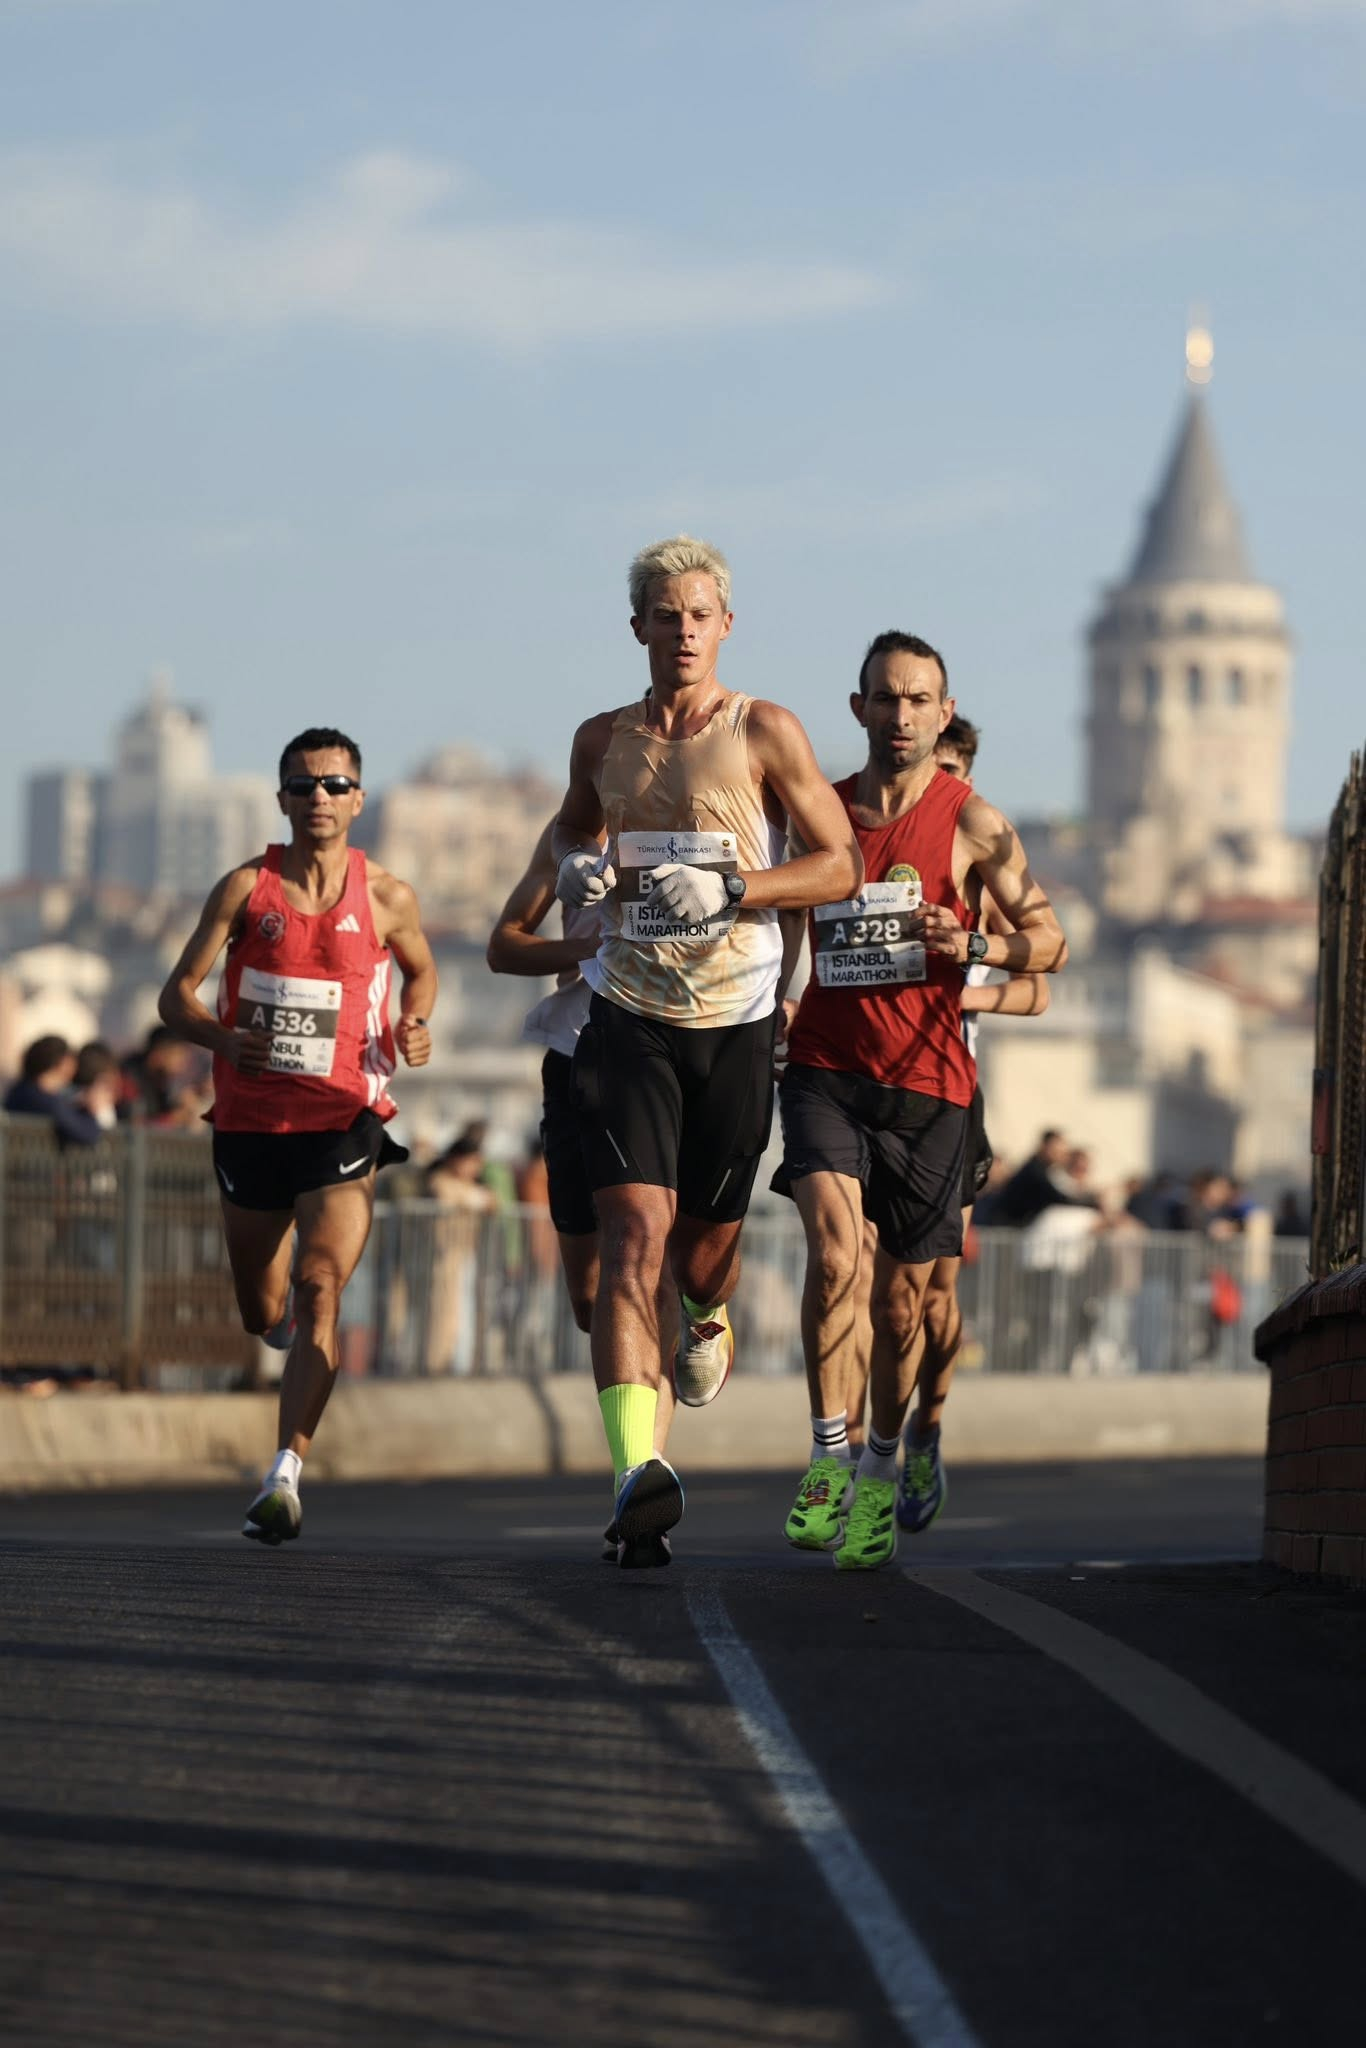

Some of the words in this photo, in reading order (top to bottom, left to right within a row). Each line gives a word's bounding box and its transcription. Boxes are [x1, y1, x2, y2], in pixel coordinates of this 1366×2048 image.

[638, 906, 666, 920] ISTA
[637, 925, 709, 936] MARATHON
[832, 922, 847, 944] A
[853, 919, 901, 943] 328
[832, 952, 895, 968] ISTANBUL
[831, 969, 897, 983] MARATHON
[251, 1006, 266, 1028] A
[272, 1010, 317, 1036] 536
[271, 1041, 304, 1056] NBUL
[270, 1057, 305, 1070] THON
